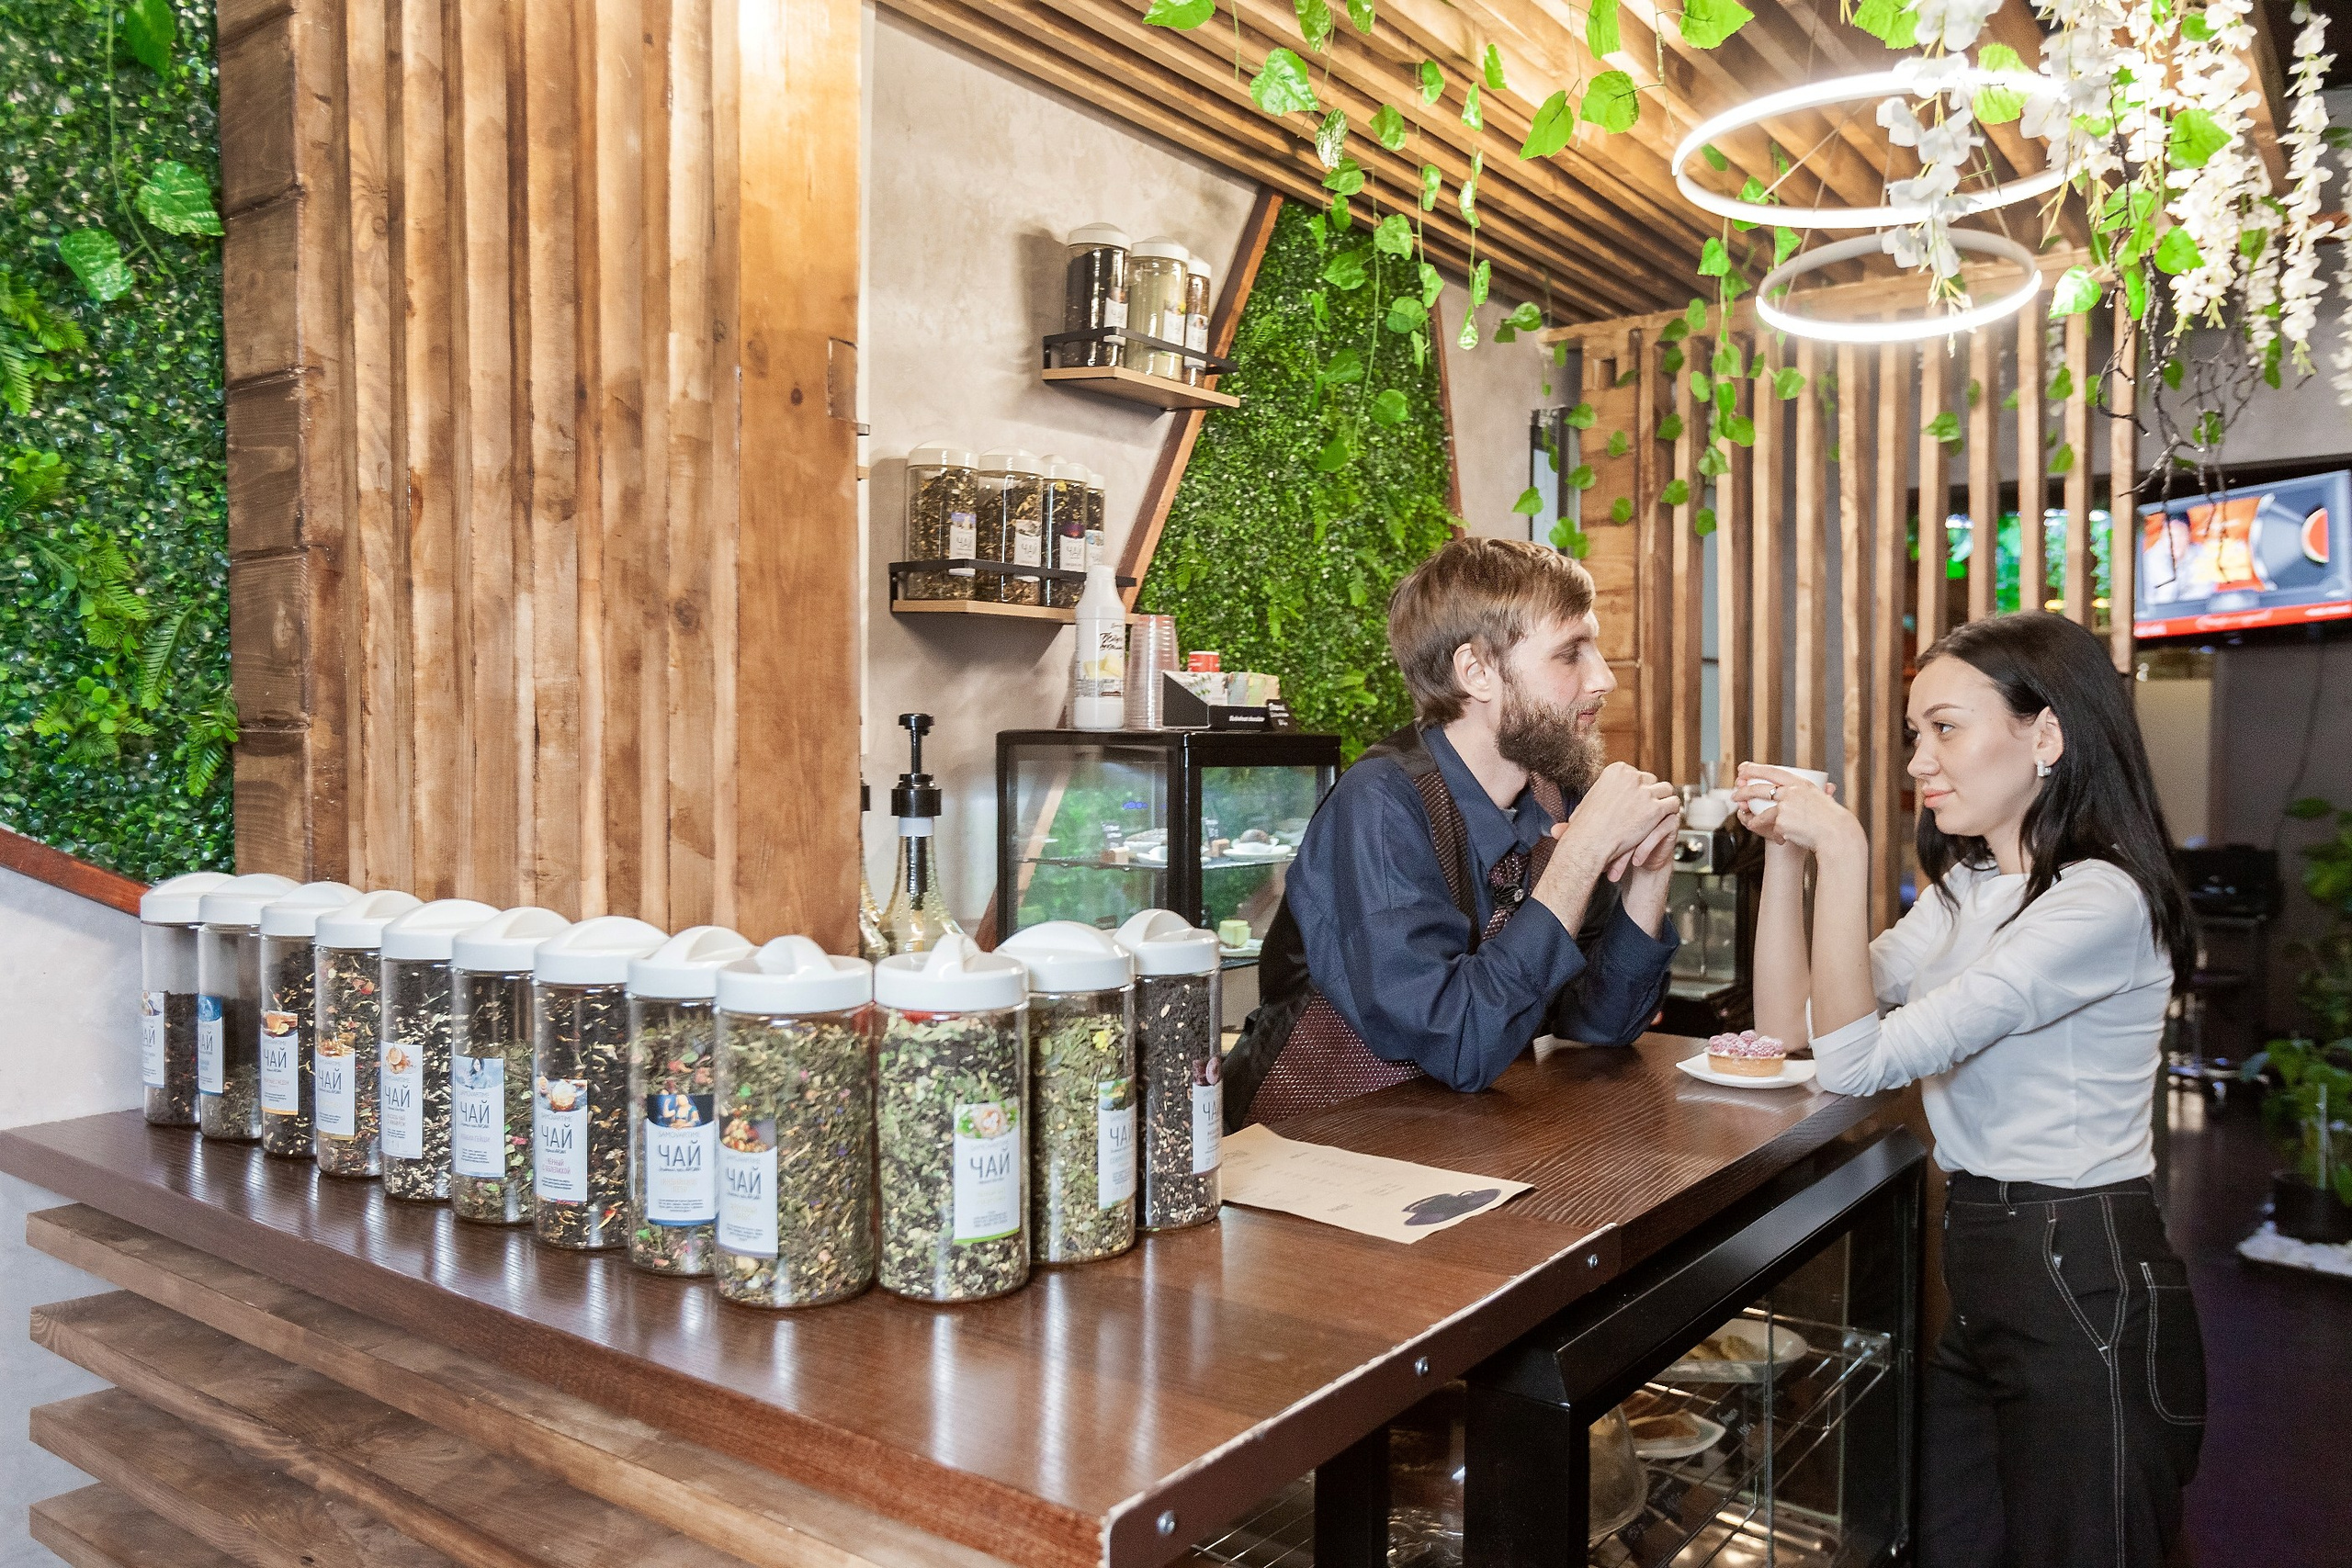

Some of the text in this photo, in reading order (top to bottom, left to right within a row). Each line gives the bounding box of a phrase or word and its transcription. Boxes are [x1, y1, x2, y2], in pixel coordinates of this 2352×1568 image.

[264, 1047, 287, 1068] ЧАЙ
[318, 1067, 342, 1090] ЧАЙ
[384, 1084, 411, 1108] ЧАЙ
[460, 1100, 490, 1124] ЧАЙ
[541, 1122, 572, 1149] ЧАЙ
[659, 1139, 701, 1167] ЧАЙ
[970, 1148, 1011, 1179] ЧАЙ
[728, 1167, 762, 1195] ЧАЙ
